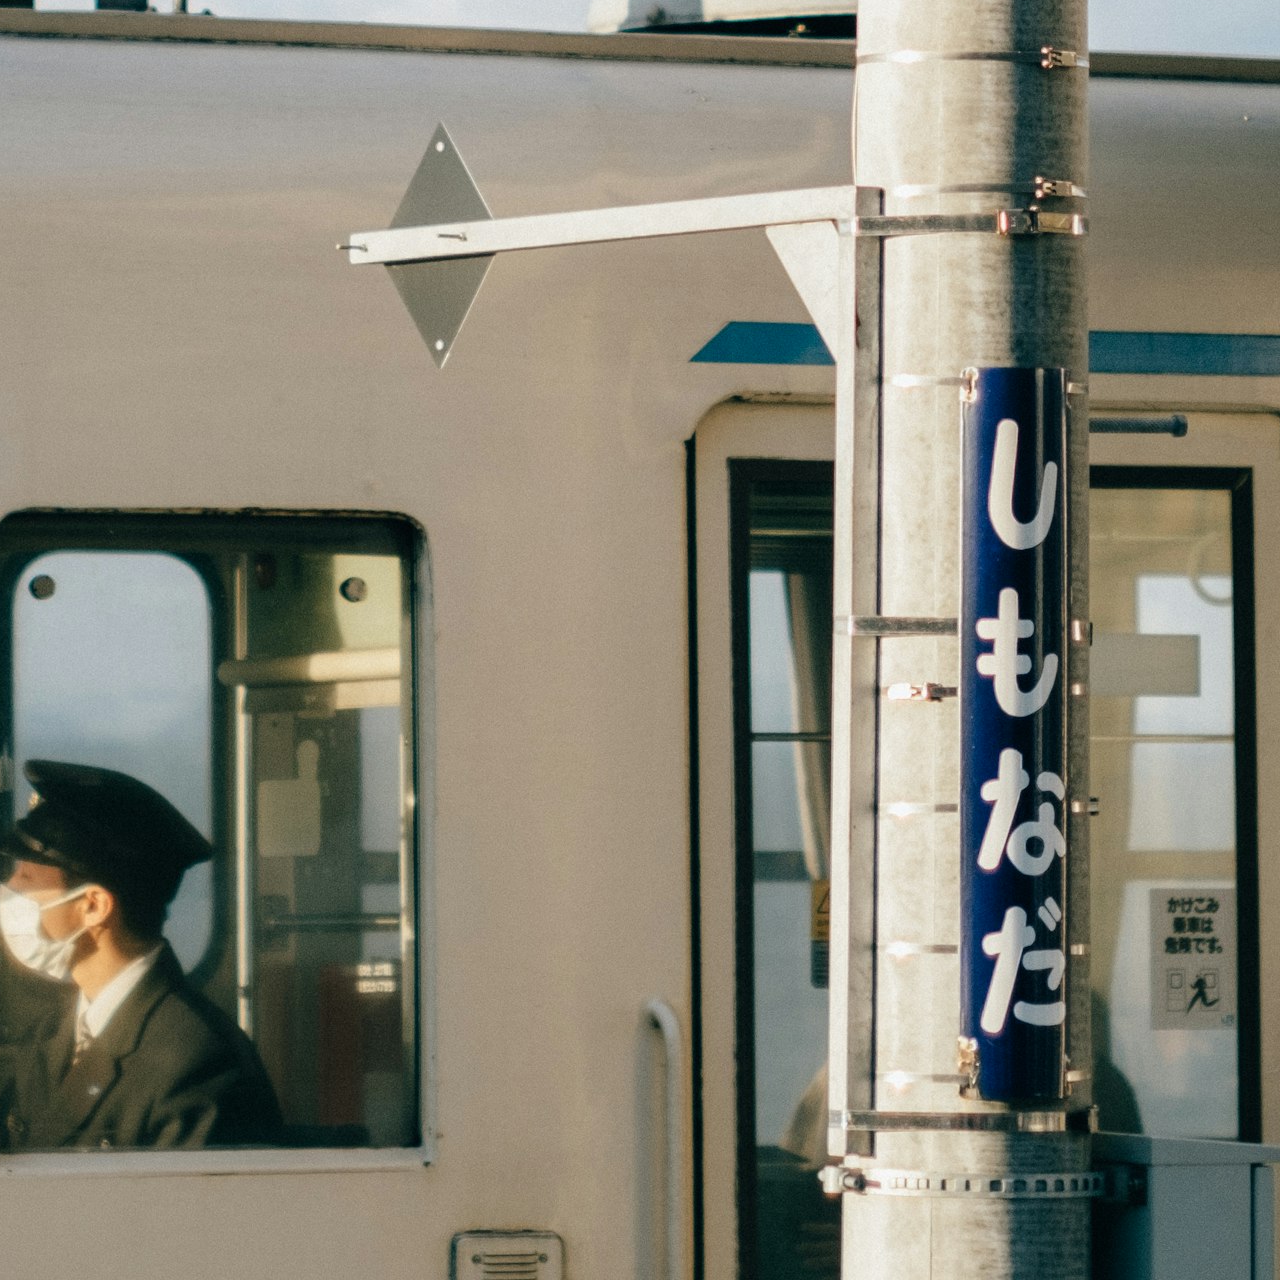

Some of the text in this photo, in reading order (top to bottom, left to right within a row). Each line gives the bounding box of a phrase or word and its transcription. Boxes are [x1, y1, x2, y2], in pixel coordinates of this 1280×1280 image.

[976, 418, 1066, 1034] しもなだ
[1167, 897, 1219, 914] かけこみ
